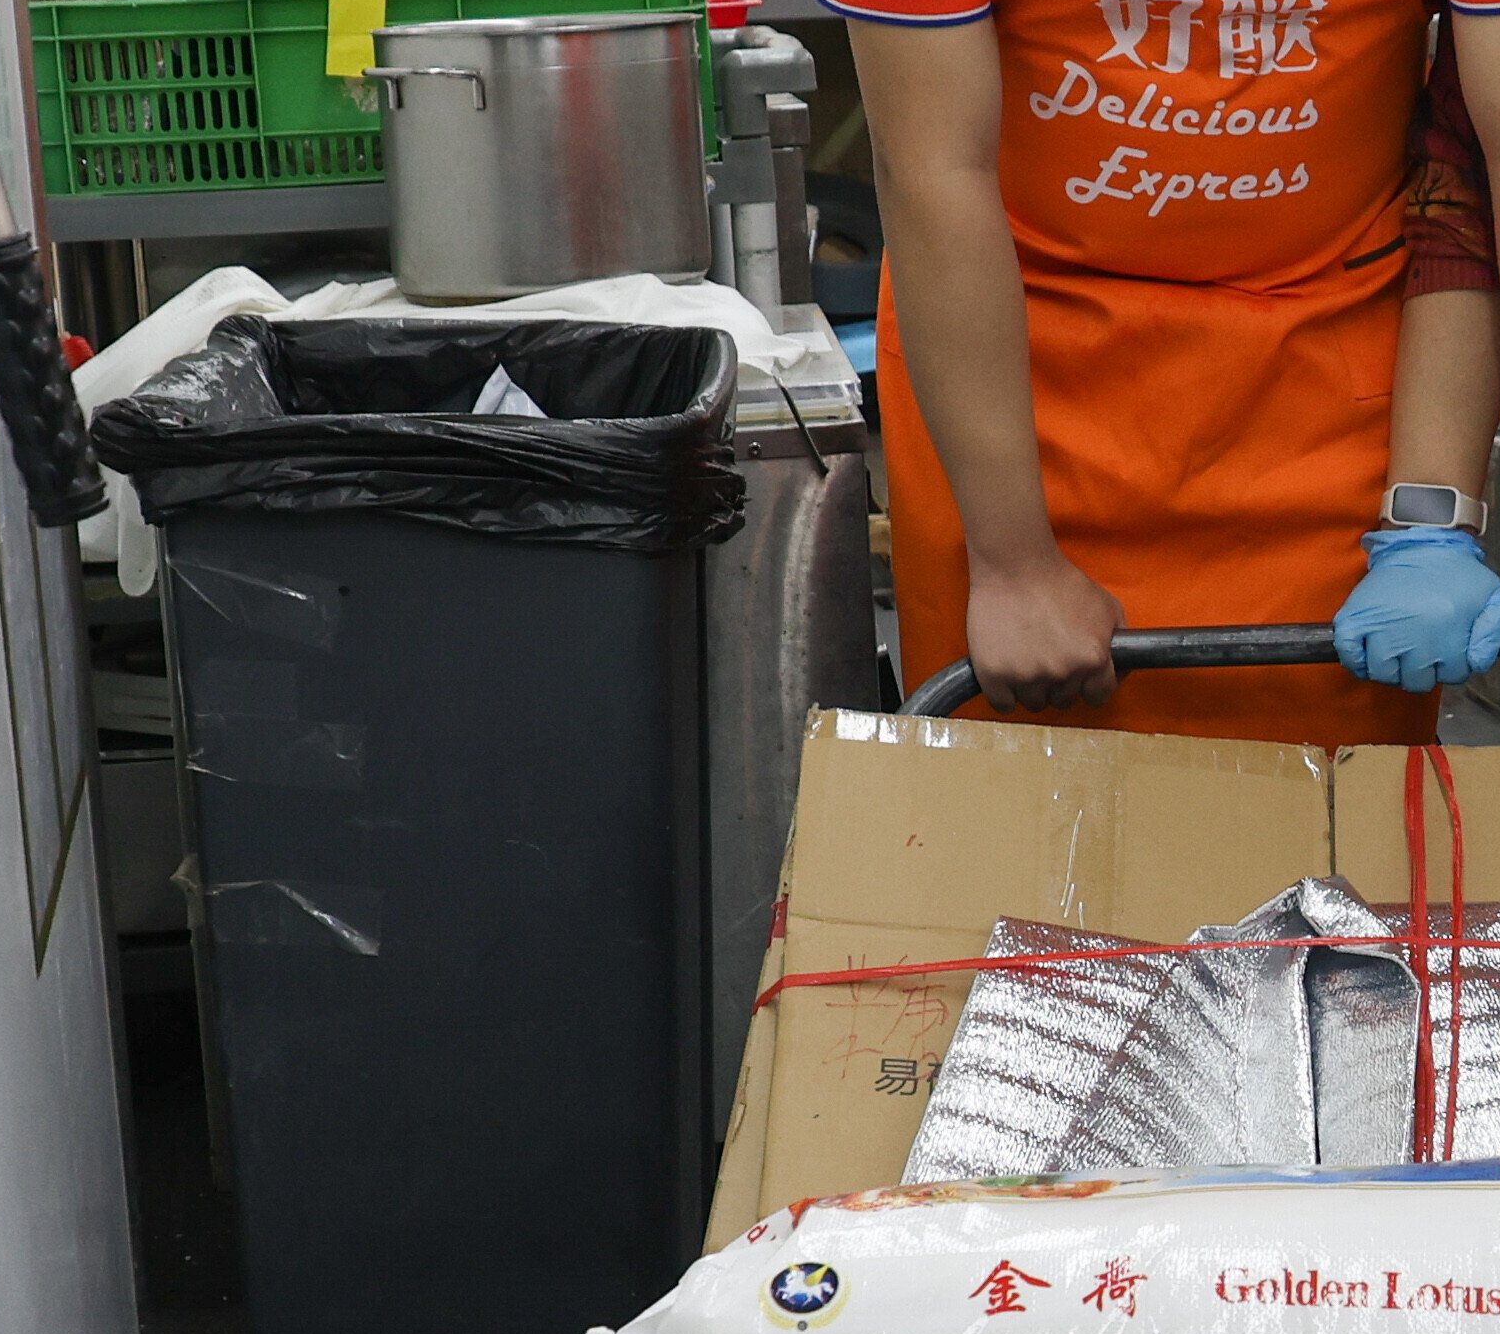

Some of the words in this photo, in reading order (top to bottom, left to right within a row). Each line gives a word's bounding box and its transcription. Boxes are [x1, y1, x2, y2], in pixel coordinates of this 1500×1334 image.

[1029, 59, 1319, 136] Delicious
[1064, 145, 1310, 218] Express
[968, 1255, 1149, 1319] 金荷
[1214, 1266, 1370, 1311] Golden
